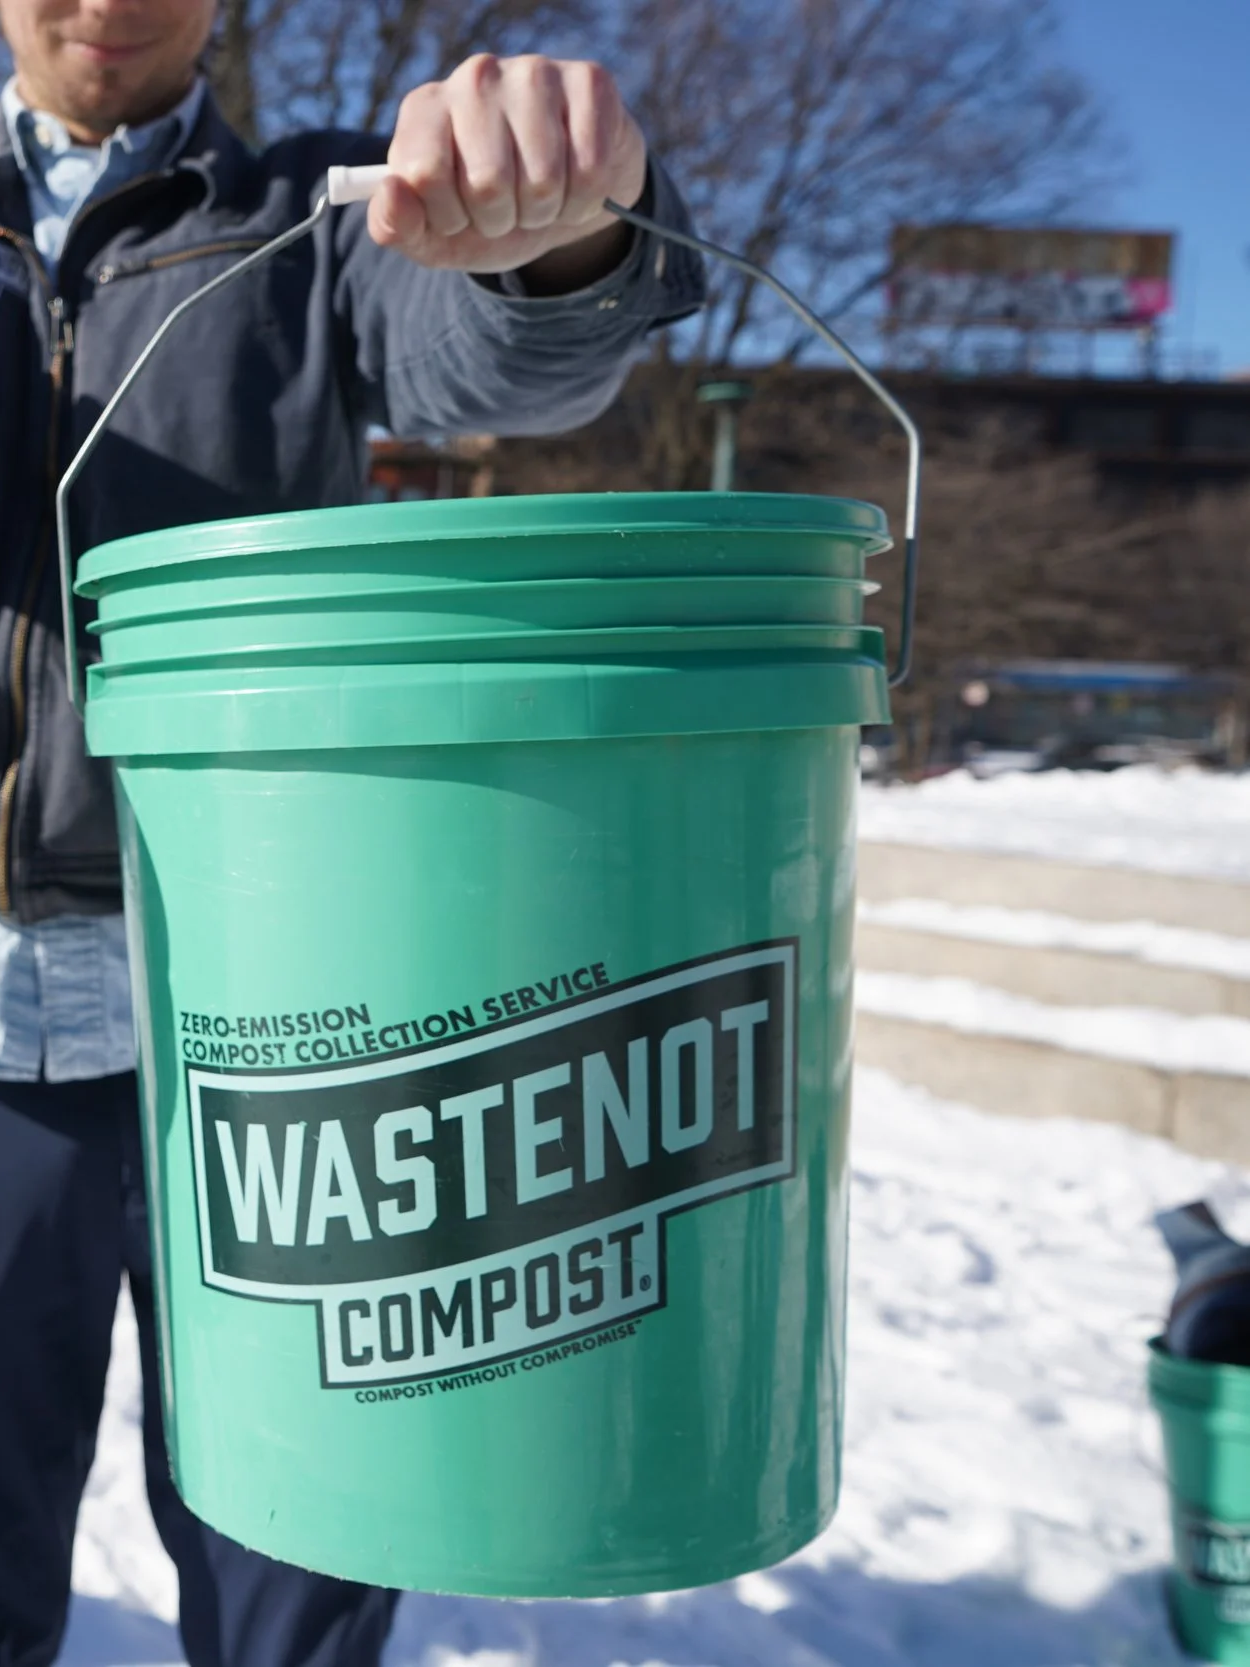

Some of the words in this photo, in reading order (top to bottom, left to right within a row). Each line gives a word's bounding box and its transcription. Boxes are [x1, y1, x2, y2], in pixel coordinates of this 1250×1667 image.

[180, 1003, 371, 1038] ZERO-EMISSION
[182, 1038, 287, 1066] COMPOST
[295, 1005, 476, 1063] COLLECTION
[482, 962, 610, 1022] SERVICE
[215, 999, 769, 1247] WASTENOT
[355, 1382, 434, 1404] COMPOST
[439, 1361, 517, 1392] WITHOUT
